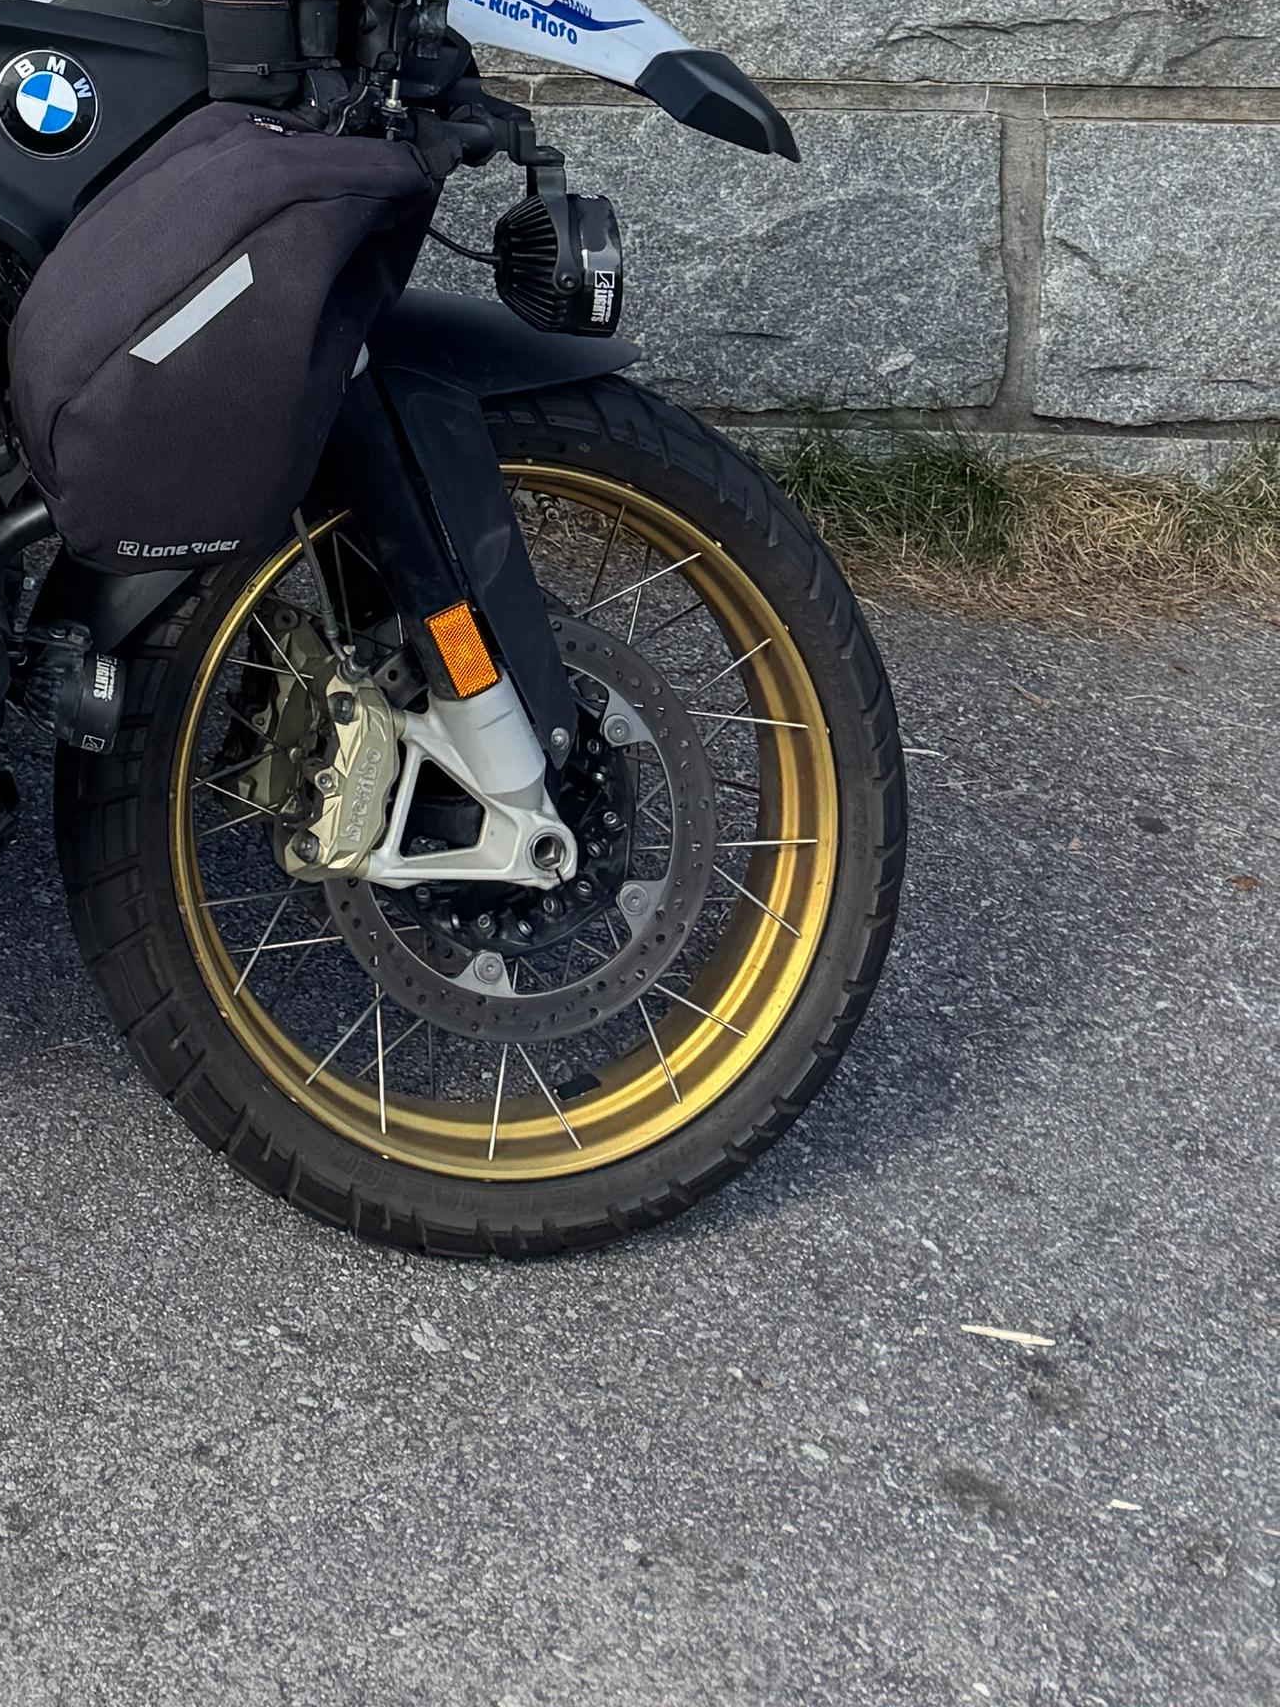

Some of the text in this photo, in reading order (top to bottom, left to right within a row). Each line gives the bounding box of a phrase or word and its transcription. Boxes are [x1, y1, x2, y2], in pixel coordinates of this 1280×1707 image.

[14, 55, 93, 99] BMW
[142, 544, 188, 557] Lone
[191, 540, 240, 554] Rider
